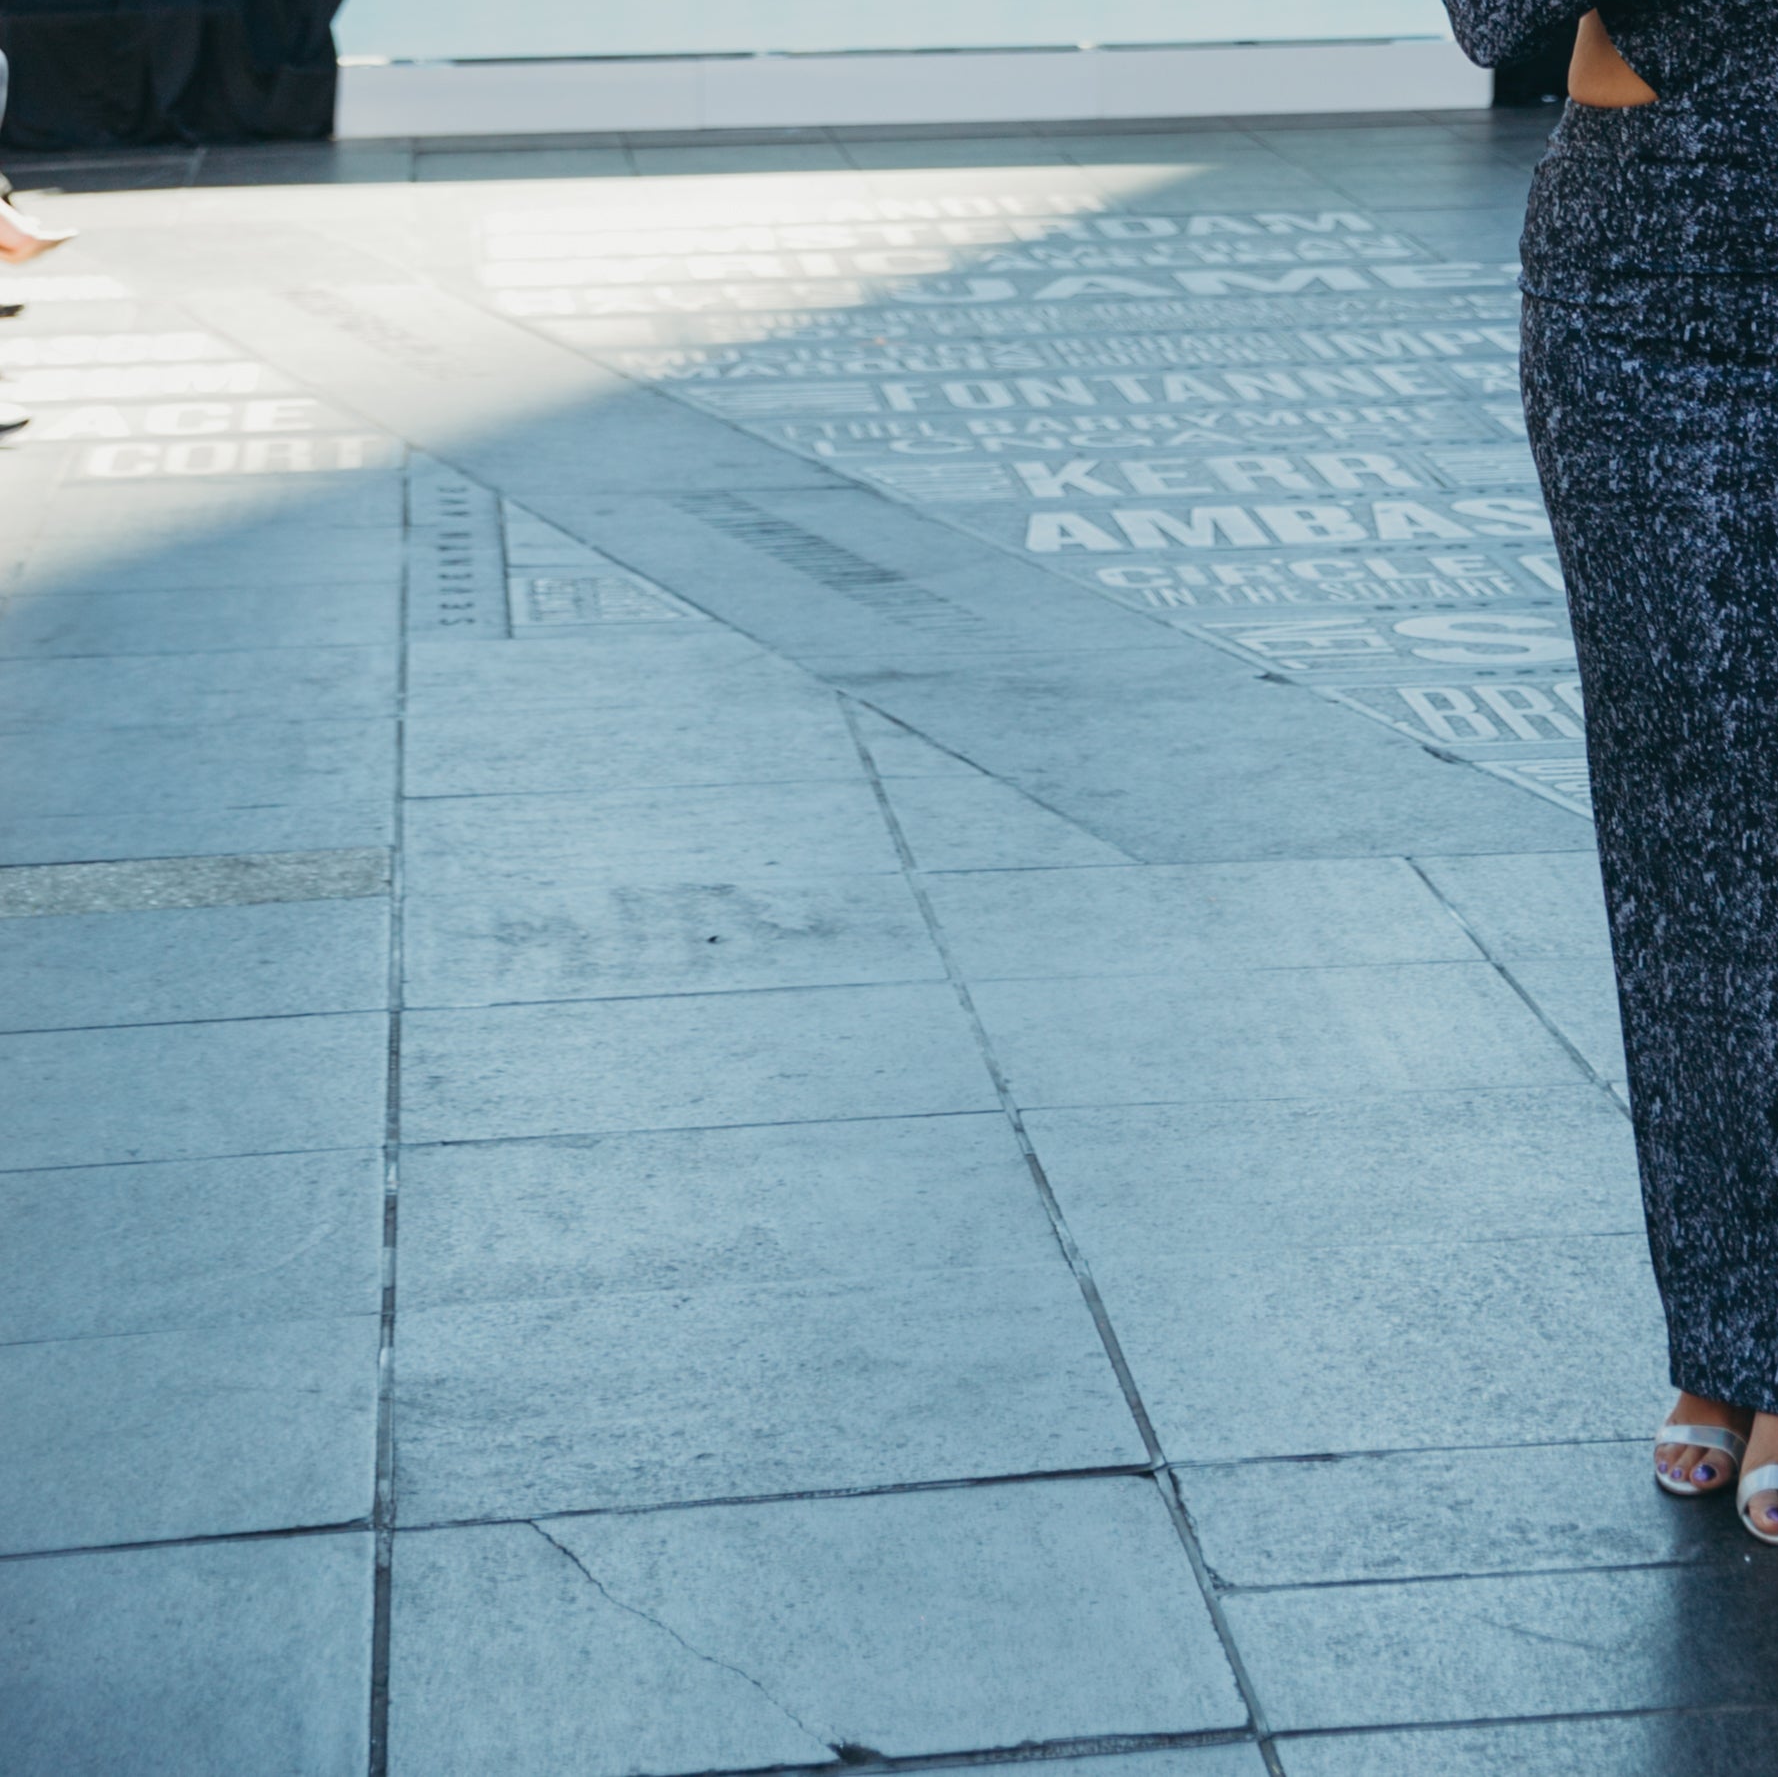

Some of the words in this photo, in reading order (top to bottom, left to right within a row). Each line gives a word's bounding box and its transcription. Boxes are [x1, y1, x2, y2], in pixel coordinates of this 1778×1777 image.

[879, 363, 1448, 412] FONTANNE
[81, 434, 380, 479] CORT
[813, 423, 1463, 458] LONGACRE
[1010, 453, 1424, 497] KERR
[1096, 554, 1507, 588] CIRCLE
[1142, 588, 1196, 608] IN
[1218, 582, 1300, 606] THE
[1327, 575, 1519, 602] SQUARE
